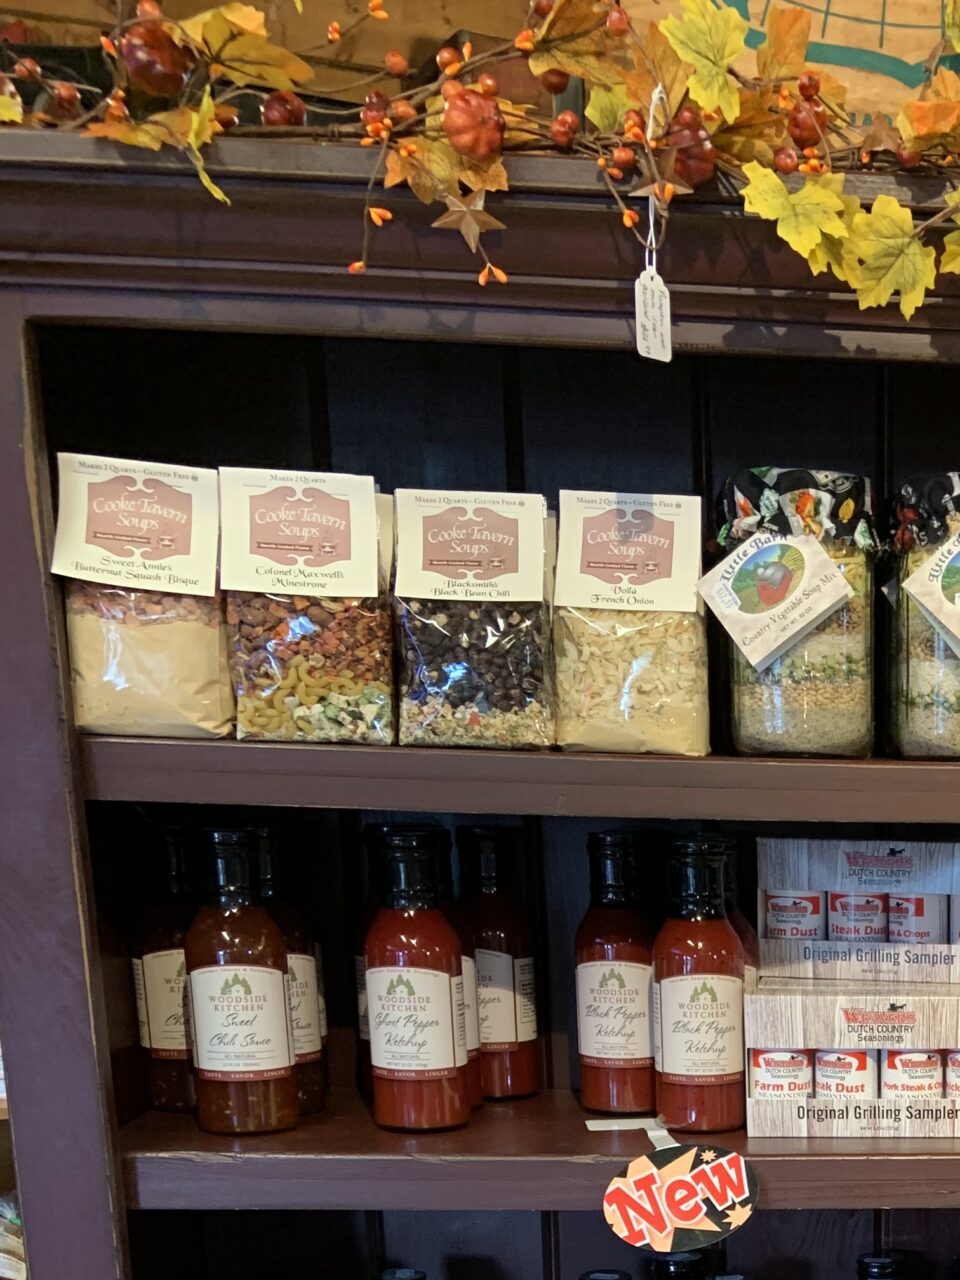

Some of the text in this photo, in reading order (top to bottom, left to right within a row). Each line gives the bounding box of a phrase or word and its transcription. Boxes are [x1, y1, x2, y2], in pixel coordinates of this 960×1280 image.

[93, 493, 187, 523] Cooke Tavern
[116, 513, 159, 535] Soups
[255, 503, 345, 530] Cooke Tavern
[278, 523, 319, 543] Soups
[428, 523, 514, 546] Cooke Tavern
[587, 524, 670, 549] Cooke Tavern
[450, 542, 488, 559] Soups
[608, 542, 645, 561] Soups
[100, 556, 134, 567] Sweet
[71, 561, 199, 586] Butternut Squash Bisque
[256, 566, 292, 575] Colonel
[272, 578, 327, 588] Minestrone
[430, 588, 458, 596] Black
[489, 590, 511, 598] Chili
[591, 595, 654, 605] French Onion
[742, 622, 772, 646] Country
[769, 598, 804, 625] Vegetable
[803, 584, 822, 600] Soup
[819, 570, 837, 588] Mix
[849, 868, 912, 878] DUTCH COUNTRY
[803, 946, 957, 966] Original Grilling Sampler
[209, 995, 267, 1003] WOODSIDE
[377, 995, 431, 1004] WOODSIDE
[214, 1004, 264, 1012] KITCHEN
[382, 1004, 426, 1012] KITCHEN
[586, 1005, 611, 1017] Black
[374, 1013, 440, 1033] Ghost Pepper
[672, 1021, 736, 1039] Black Pepper
[848, 1025, 914, 1034] DUTCH COUNTRY
[209, 1033, 272, 1047] Chili Sauce
[384, 1032, 427, 1052] Ketchup
[858, 1033, 904, 1043] Seasonings
[685, 1040, 726, 1058] Ketchup
[755, 1080, 811, 1091] Farm Dust
[884, 1082, 898, 1091] Pork
[797, 1106, 960, 1122] Original Grilling Sampler
[604, 1152, 749, 1247] New
